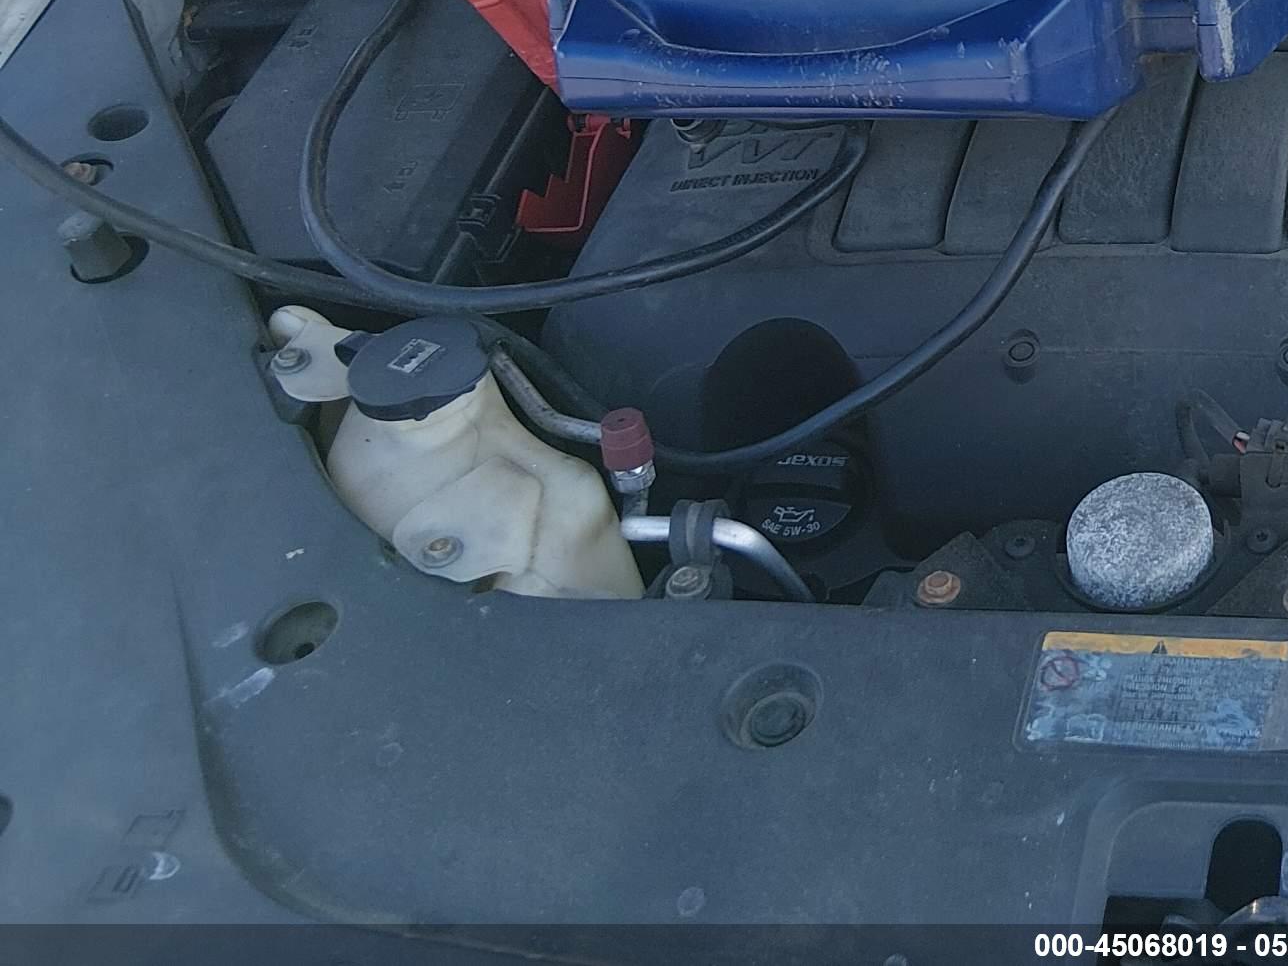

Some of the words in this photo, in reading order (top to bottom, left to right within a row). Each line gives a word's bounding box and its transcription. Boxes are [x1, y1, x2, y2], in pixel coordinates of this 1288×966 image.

[670, 176, 731, 192] DIRECT
[732, 169, 817, 185] INJECTION
[761, 518, 781, 535] SAE
[783, 521, 821, 537] 5W-30
